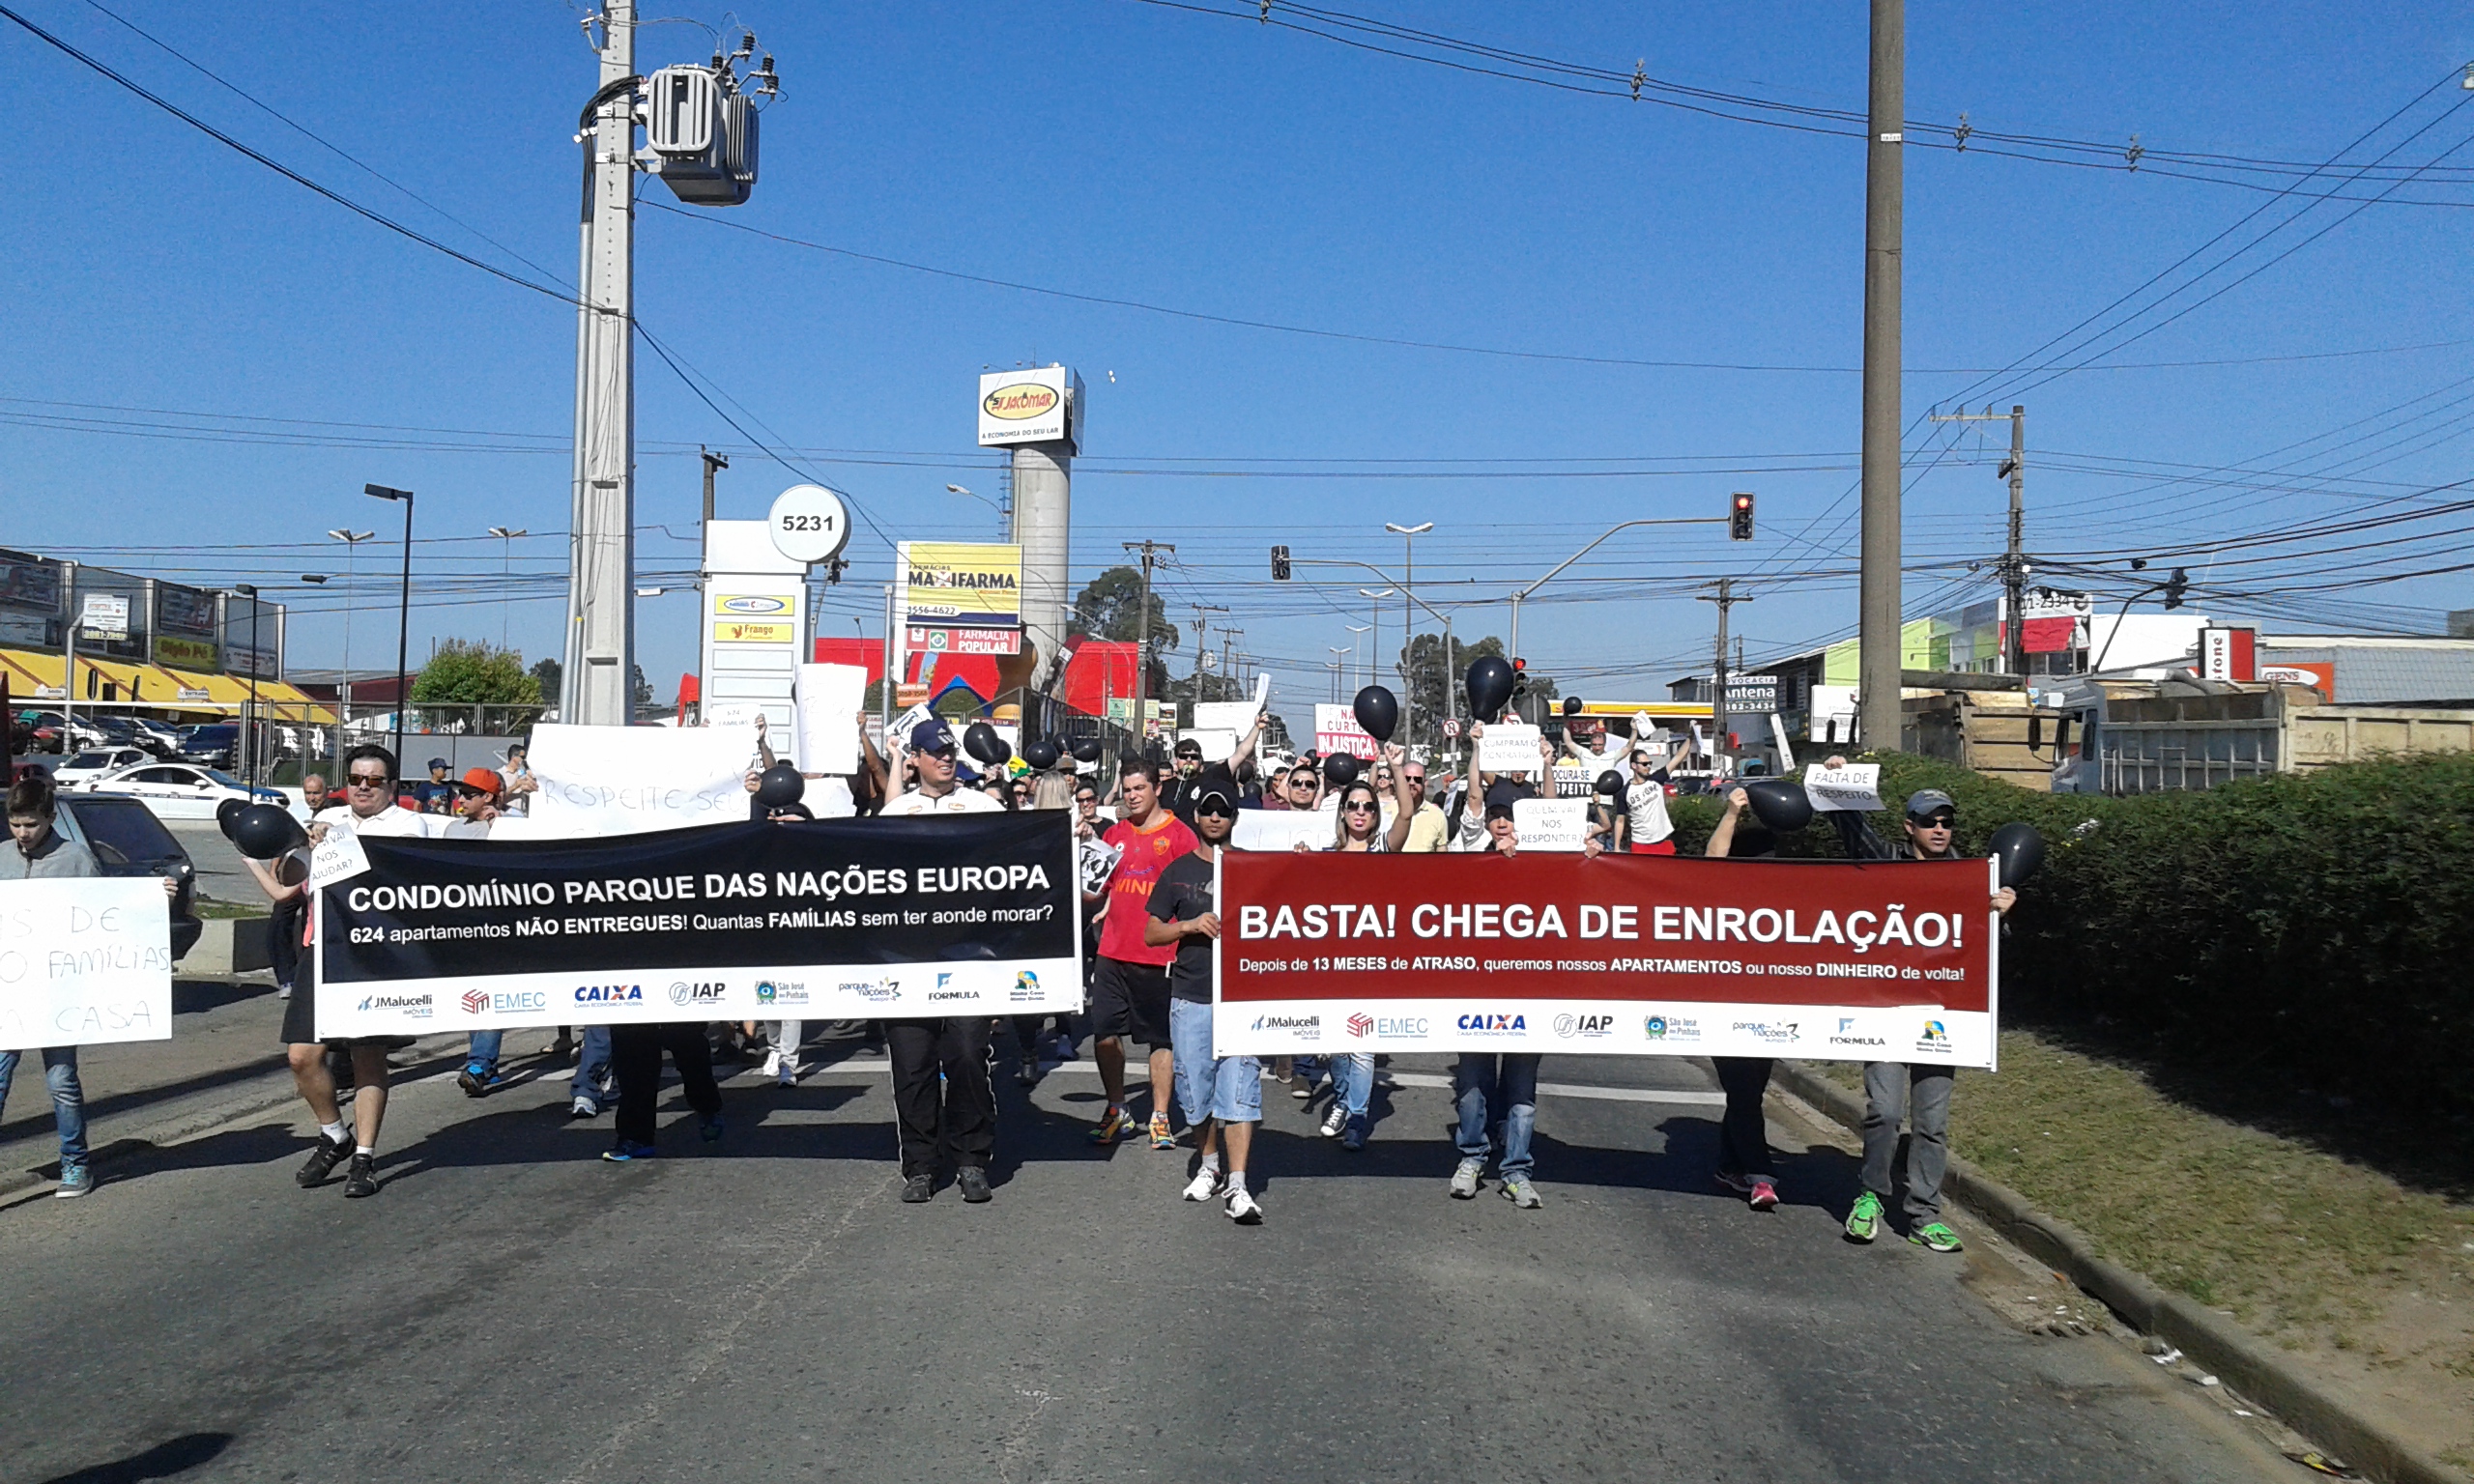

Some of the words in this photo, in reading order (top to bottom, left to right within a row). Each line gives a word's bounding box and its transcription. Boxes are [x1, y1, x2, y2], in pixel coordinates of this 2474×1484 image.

[988, 430, 1021, 440] ECONOMIA
[782, 515, 833, 531] 5231
[744, 624, 774, 636] Frango
[958, 641, 1009, 653] POPULAR
[1318, 734, 1374, 759] INJUSTIÇA
[1814, 772, 1850, 784] FALTA
[1853, 772, 1870, 784] DE
[544, 779, 679, 812] RESPEITE
[1816, 789, 1872, 801] RESPEITO
[1541, 819, 1563, 829] NOS
[330, 831, 346, 843] VAI
[1520, 833, 1584, 843] RESPONDER?
[316, 850, 339, 864] NOS
[312, 859, 354, 881] AJUDAR?
[349, 878, 556, 912] CONDOMÍNIO
[563, 875, 696, 904] PARQUE
[705, 872, 767, 899] DAS
[776, 865, 907, 901] NAÇÕES
[917, 865, 1051, 894] EUROPA
[72, 906, 120, 933] DE
[350, 927, 385, 944] 624
[389, 924, 510, 945] apartamentos
[515, 916, 559, 936] NÃO
[564, 914, 688, 934] ENTREGUES!
[693, 913, 763, 930] Quantas
[768, 907, 856, 928] FAMÍLIAS
[861, 911, 899, 927] sem
[904, 909, 928, 925] ter
[932, 906, 988, 925] aonde
[992, 904, 1053, 922] morar?
[1240, 904, 1396, 939] BASTA!
[1411, 903, 1568, 939] CHEGA
[1579, 904, 1639, 939] DE
[1654, 903, 1963, 953] ENROLAÇÃO!
[1239, 957, 1287, 974] Depois
[1291, 957, 1309, 971] de
[1312, 956, 1330, 971] 13
[1334, 956, 1387, 970] MESES
[1391, 956, 1408, 970] de
[1412, 956, 1479, 972] ATRASO,
[1483, 958, 1553, 973] queremos
[1557, 959, 1607, 972] nossos
[1610, 957, 1742, 974] APARTAMENTOS
[1745, 963, 1765, 976] ou
[1769, 963, 1812, 977] nosso
[1816, 962, 1897, 980] DINHEIRO
[1901, 965, 1920, 980] de
[1925, 967, 1965, 981] volta!
[574, 985, 643, 1002] CAIXA
[692, 982, 726, 997] IAP
[838, 983, 869, 992] parque
[374, 994, 433, 1008] JMalucelli
[494, 992, 546, 1009] EMEC
[928, 990, 981, 1001] FORMULA
[55, 1000, 152, 1032] CASA
[1266, 1015, 1320, 1028] JMalucelli
[1456, 1014, 1526, 1030] CAIXA
[1578, 1015, 1614, 1031] IAP
[1378, 1018, 1428, 1034] EMEC
[1829, 1037, 1885, 1045] FORMULA
